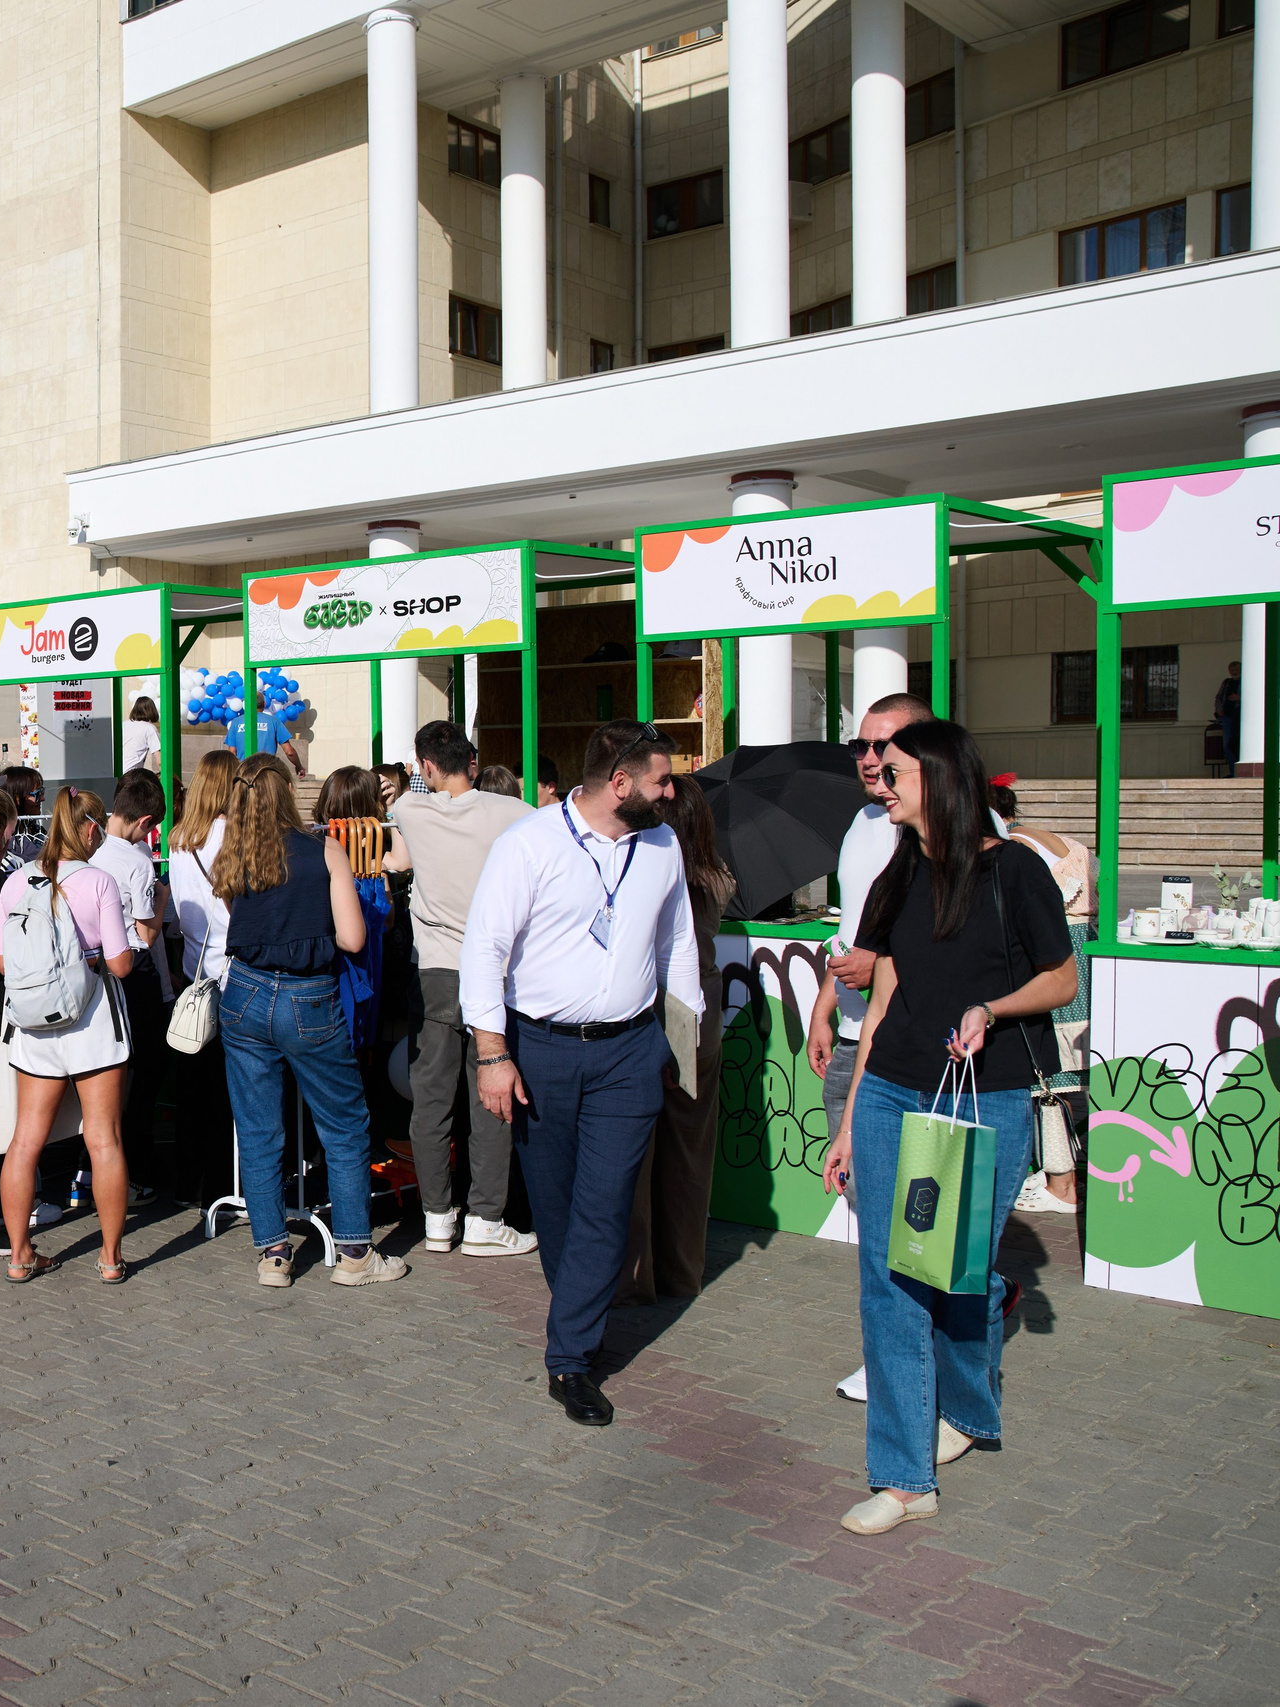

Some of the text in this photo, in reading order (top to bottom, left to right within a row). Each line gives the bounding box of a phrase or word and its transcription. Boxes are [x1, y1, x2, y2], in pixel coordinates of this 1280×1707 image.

[736, 535, 812, 563] Anna
[768, 556, 836, 586] Nikol
[735, 576, 795, 610] крафтовый сыр
[393, 595, 462, 617] SHOP
[20, 620, 65, 656] Jam
[31, 653, 66, 664] burgers
[56, 699, 91, 710] КОФЕЙНЯ
[61, 690, 85, 699] НОВАЯ
